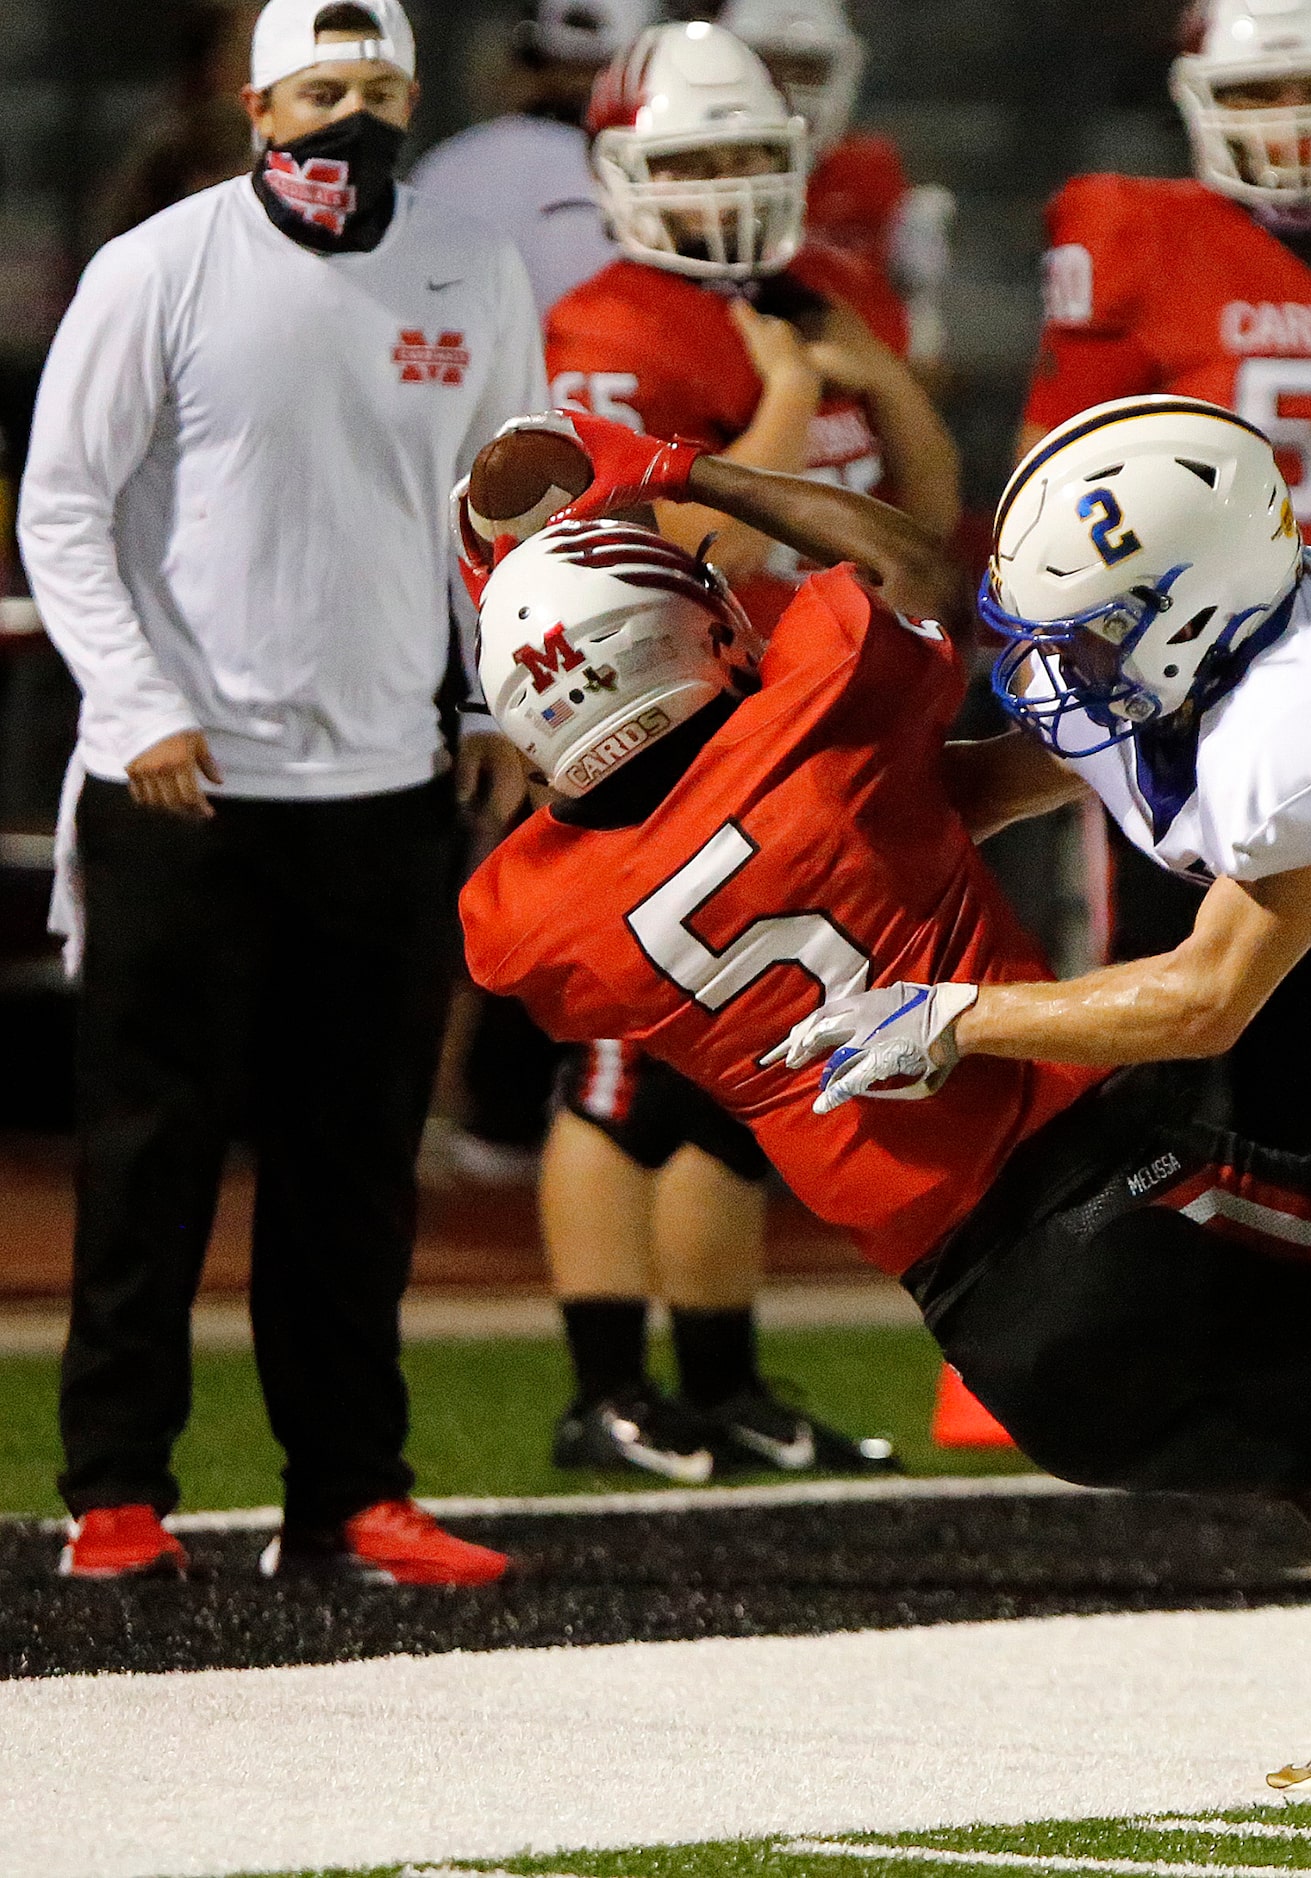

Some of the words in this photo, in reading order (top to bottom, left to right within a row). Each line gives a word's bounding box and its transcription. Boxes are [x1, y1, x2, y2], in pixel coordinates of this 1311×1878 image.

[1075, 487, 1143, 570] 2
[513, 621, 586, 695] M
[566, 706, 671, 788] CARDS
[623, 814, 876, 1067] 5
[1126, 1152, 1182, 1197] MELISSA
